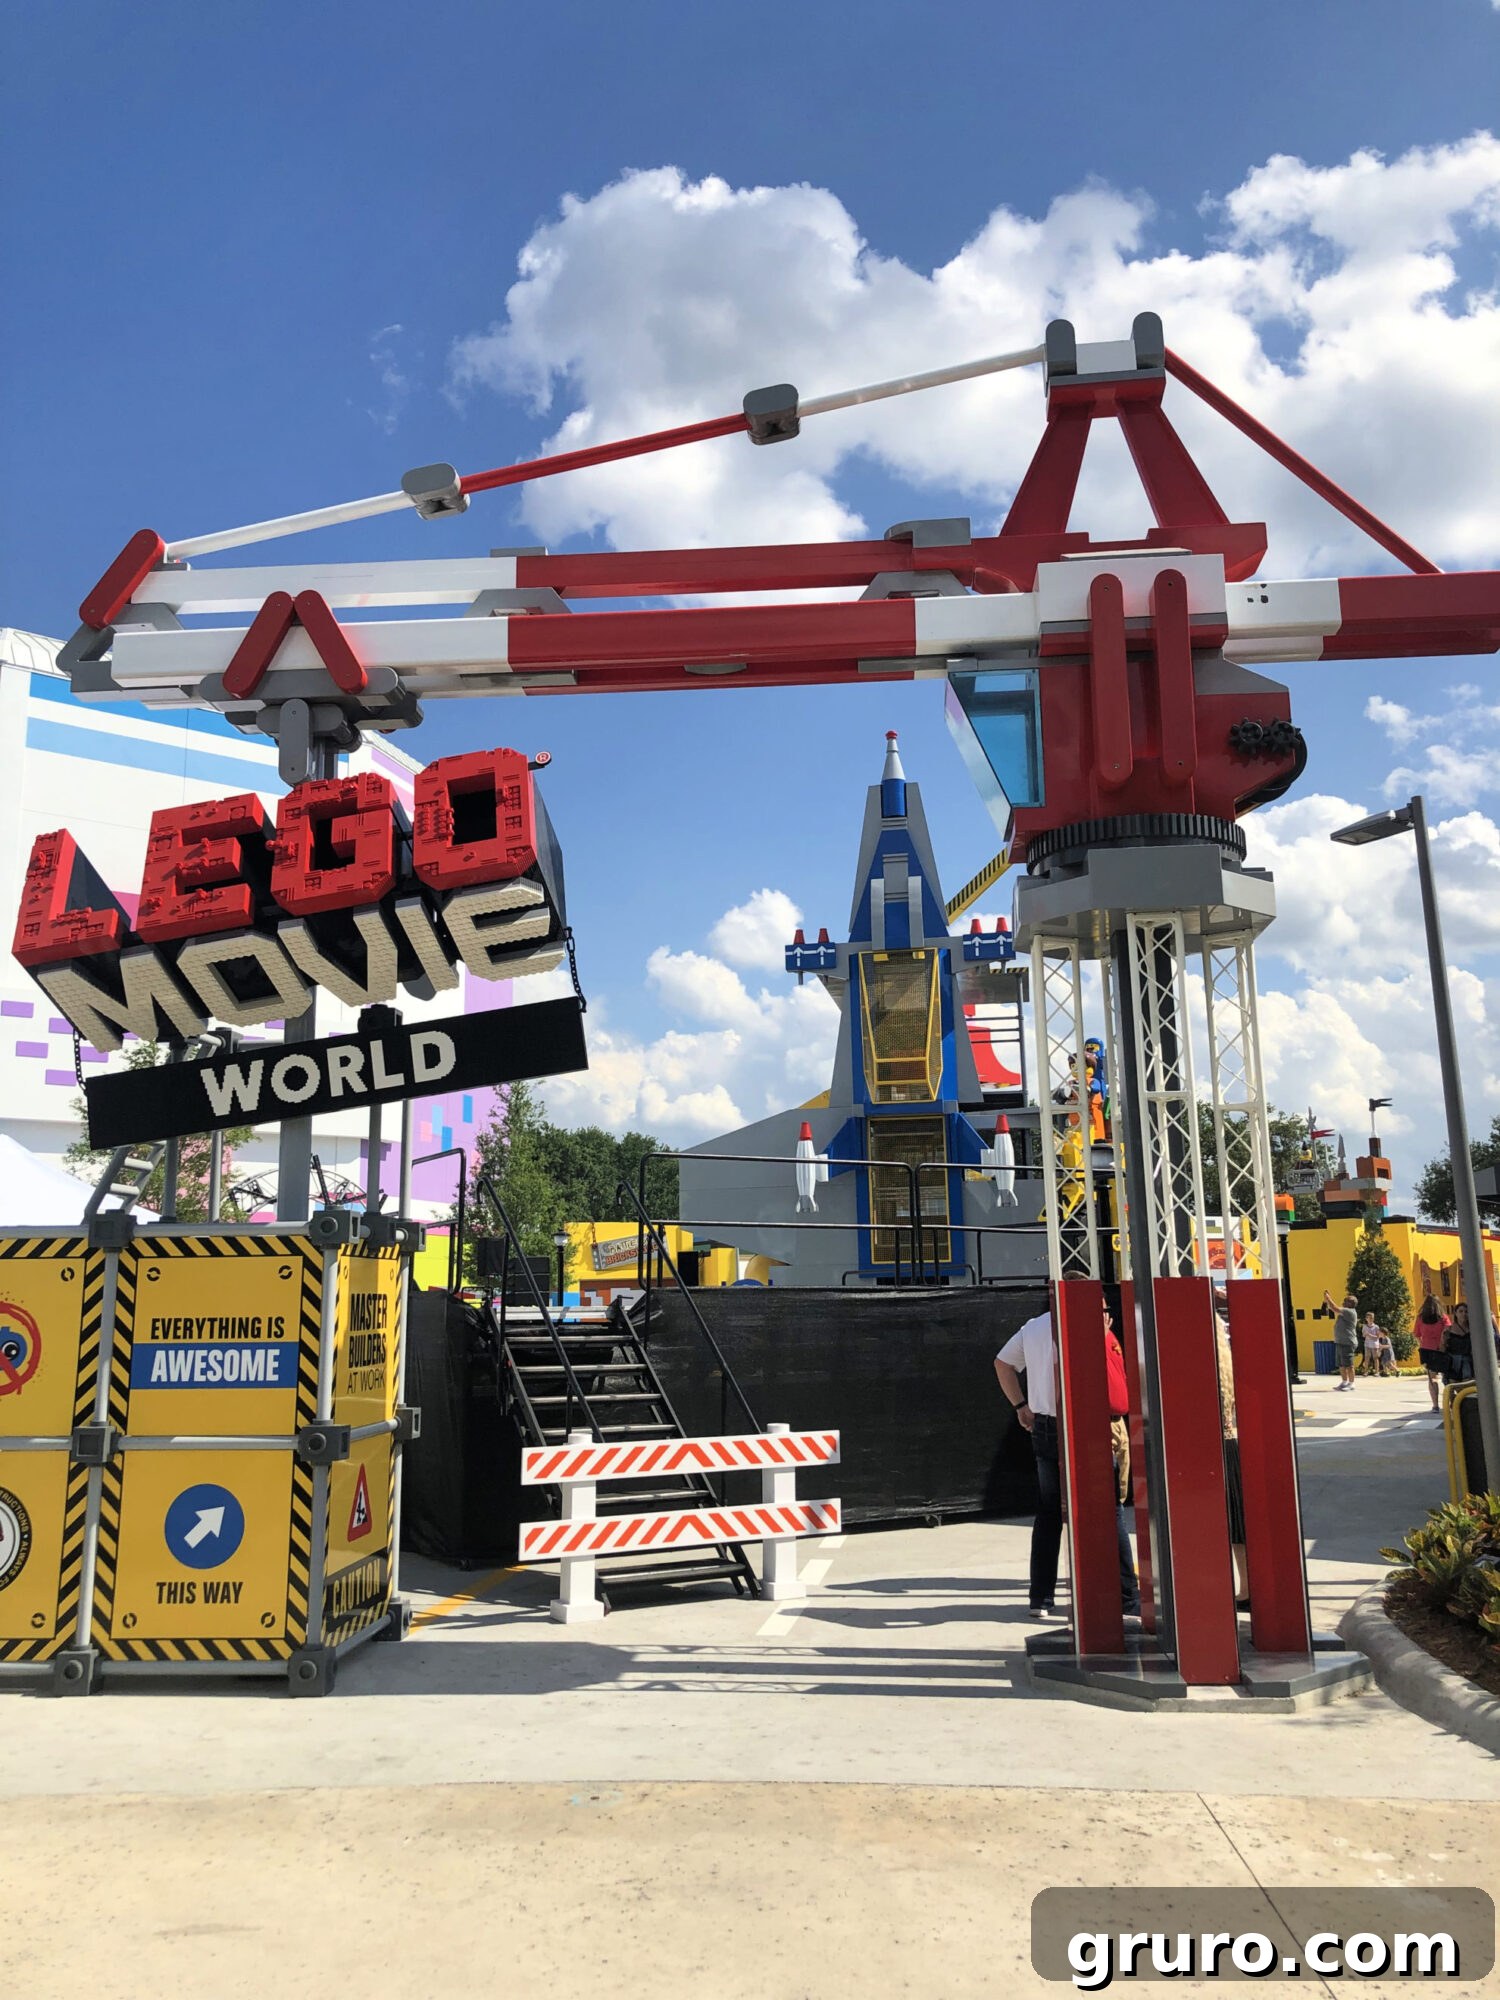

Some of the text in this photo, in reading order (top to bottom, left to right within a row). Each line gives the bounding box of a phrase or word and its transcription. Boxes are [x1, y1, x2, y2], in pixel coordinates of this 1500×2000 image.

[12, 748, 538, 967] LEGO
[38, 877, 566, 1052] MOVIE
[200, 1031, 457, 1117] WORLD
[151, 1316, 285, 1340] EVERYTHING IS
[350, 1293, 387, 1331] MASTER
[151, 1349, 280, 1382] AWESOME
[348, 1333, 387, 1369] BUILDERS
[347, 1368, 385, 1395] AT WORK
[156, 1581, 244, 1604] THIS WAY
[333, 1558, 380, 1618] CAUTION
